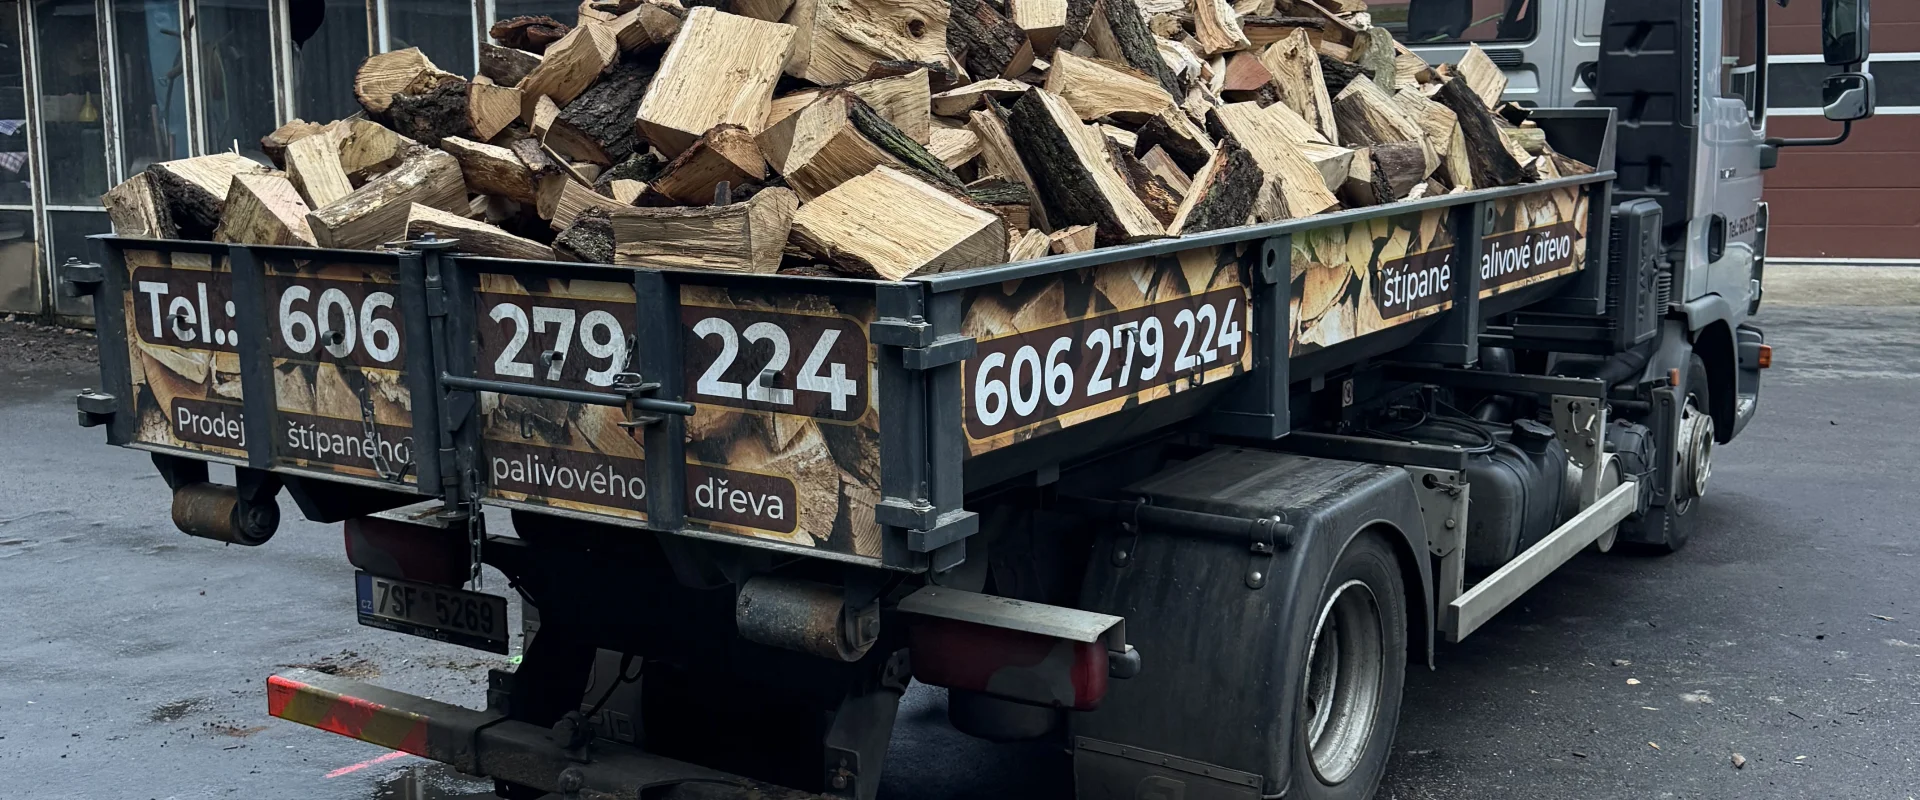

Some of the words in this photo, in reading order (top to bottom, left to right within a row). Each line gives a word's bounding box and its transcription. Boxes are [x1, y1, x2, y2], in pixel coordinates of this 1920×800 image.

[1384, 255, 1451, 312] štípané
[1480, 235, 1531, 280] alivové
[1534, 231, 1570, 266] dřevo
[139, 281, 238, 346] Tel.:
[278, 285, 400, 363] 606
[488, 302, 626, 388] 279
[692, 316, 857, 412] 224
[975, 336, 1075, 427] 606
[1086, 315, 1164, 397] 279
[1173, 298, 1242, 373] 224
[177, 406, 246, 448] Prodej
[288, 420, 410, 464] štípaného
[493, 453, 646, 501] palivového
[695, 476, 785, 520] dřeva
[361, 599, 372, 610] CZ
[377, 581, 417, 619] 7SF
[435, 592, 493, 634] 5269
